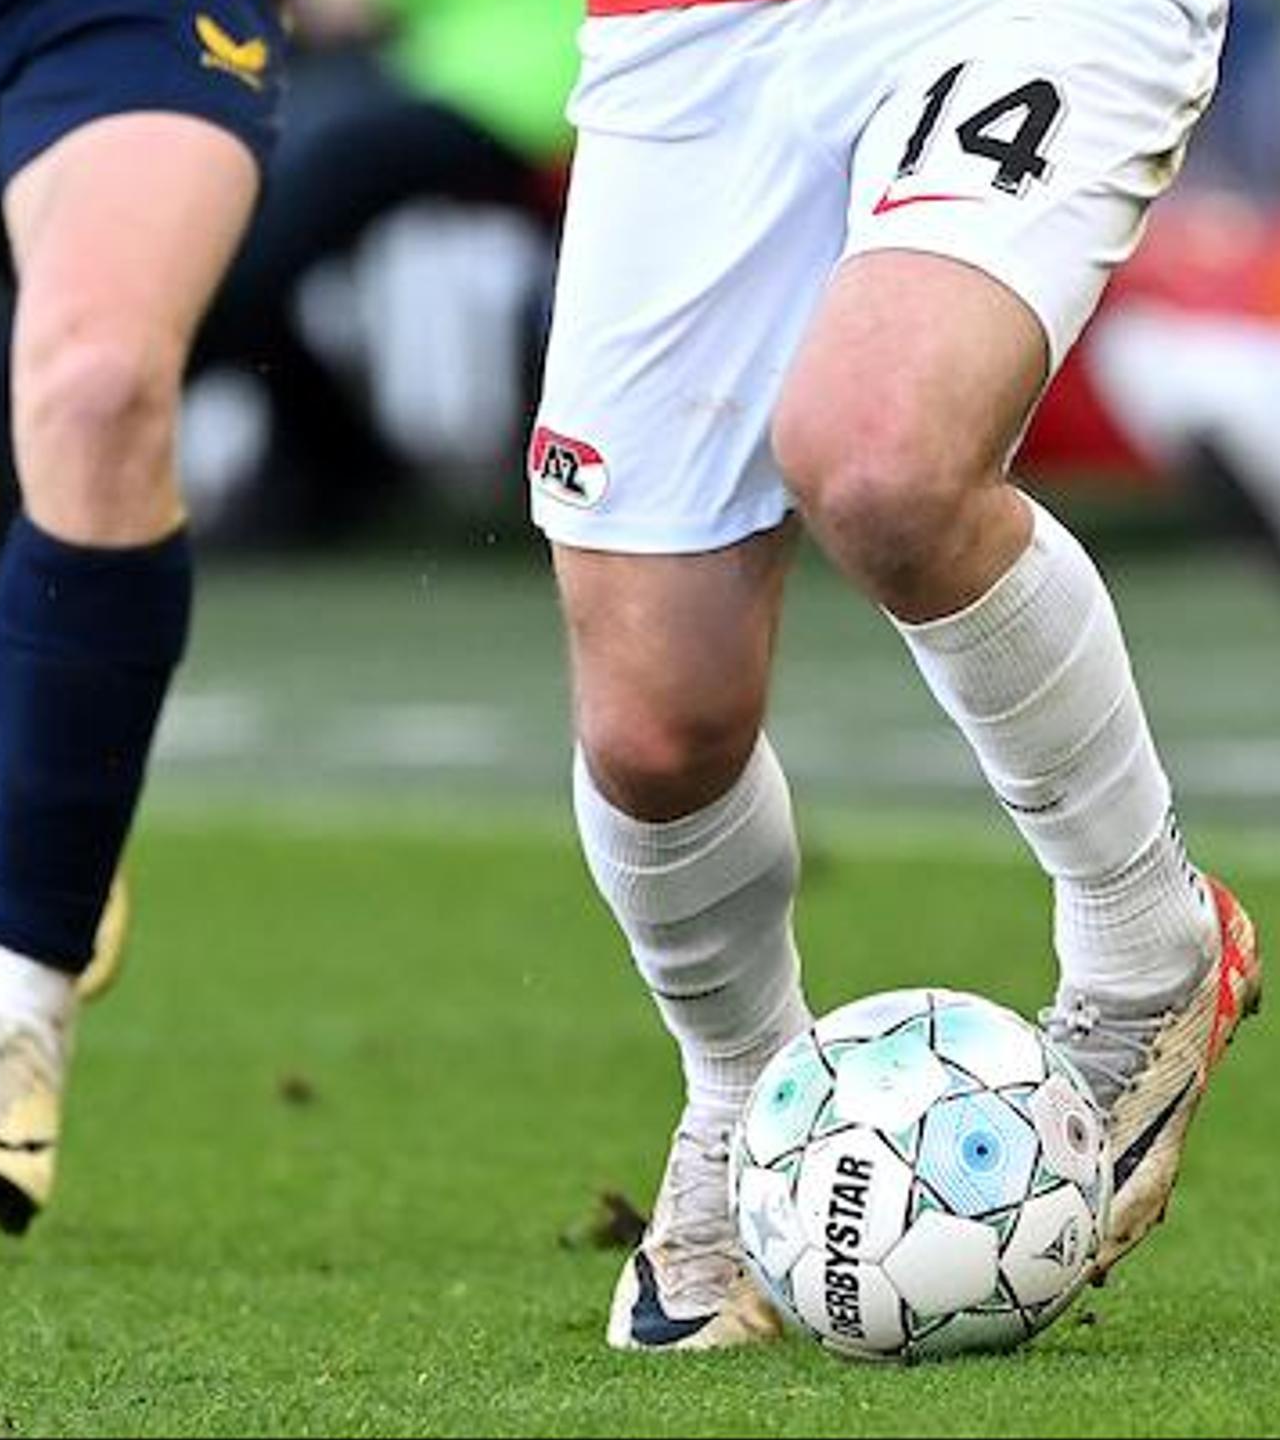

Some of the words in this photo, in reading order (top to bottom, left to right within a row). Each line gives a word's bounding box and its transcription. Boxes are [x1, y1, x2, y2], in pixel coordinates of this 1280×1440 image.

[896, 59, 1066, 197] 14
[540, 443, 587, 496] AZ
[824, 1153, 875, 1340] DERBYSTAR
